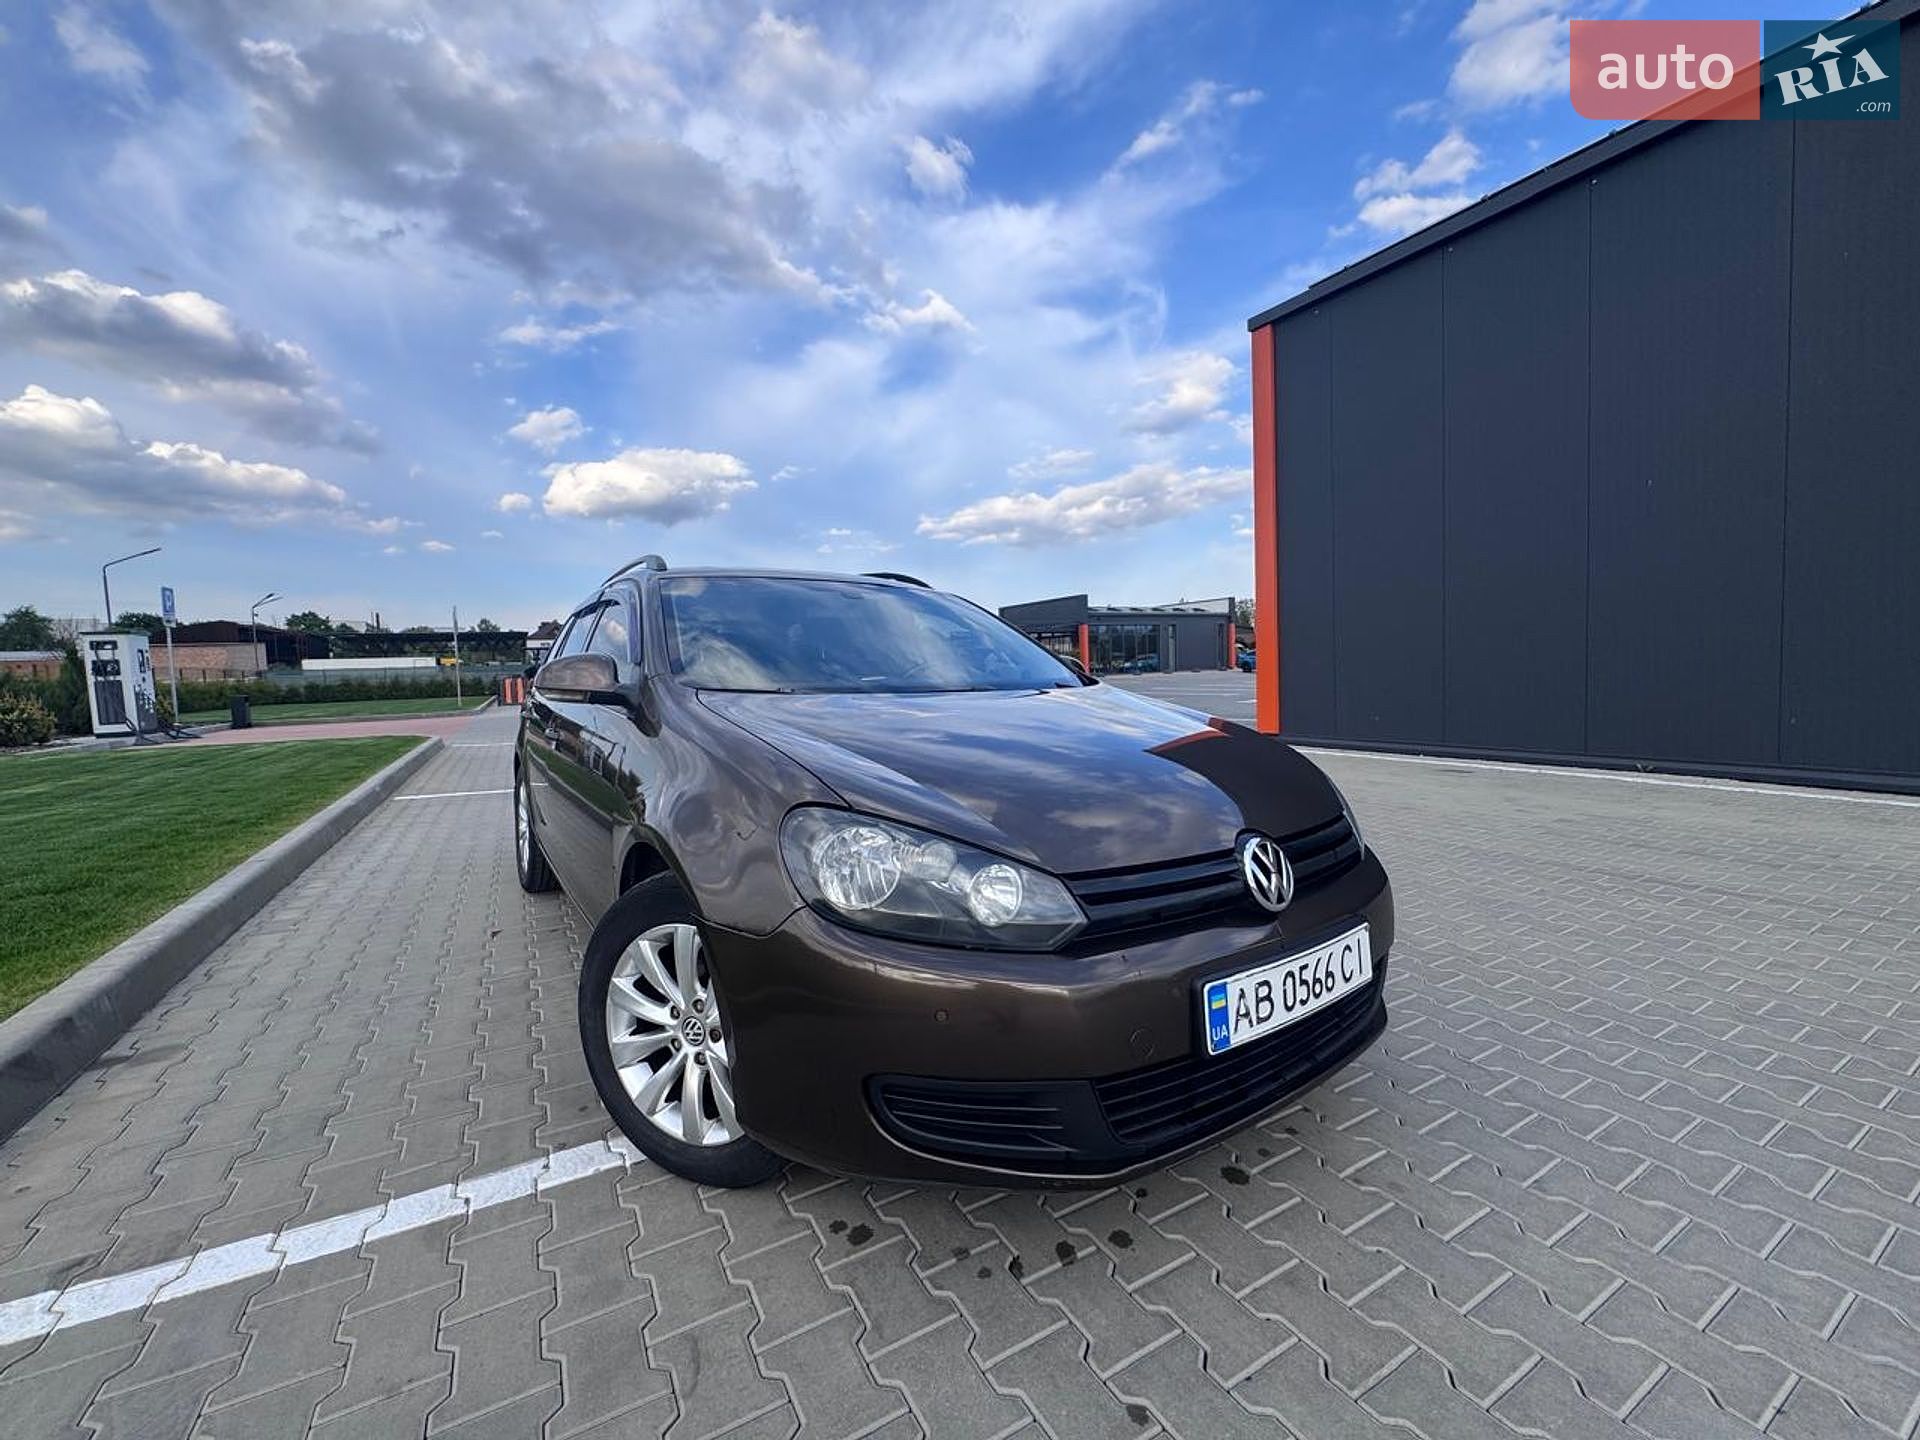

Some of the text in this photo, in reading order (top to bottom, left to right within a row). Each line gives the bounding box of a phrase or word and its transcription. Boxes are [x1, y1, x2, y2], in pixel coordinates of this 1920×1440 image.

[1233, 938, 1363, 1034] AB 0566 CI
[1212, 1024, 1228, 1041] UA
